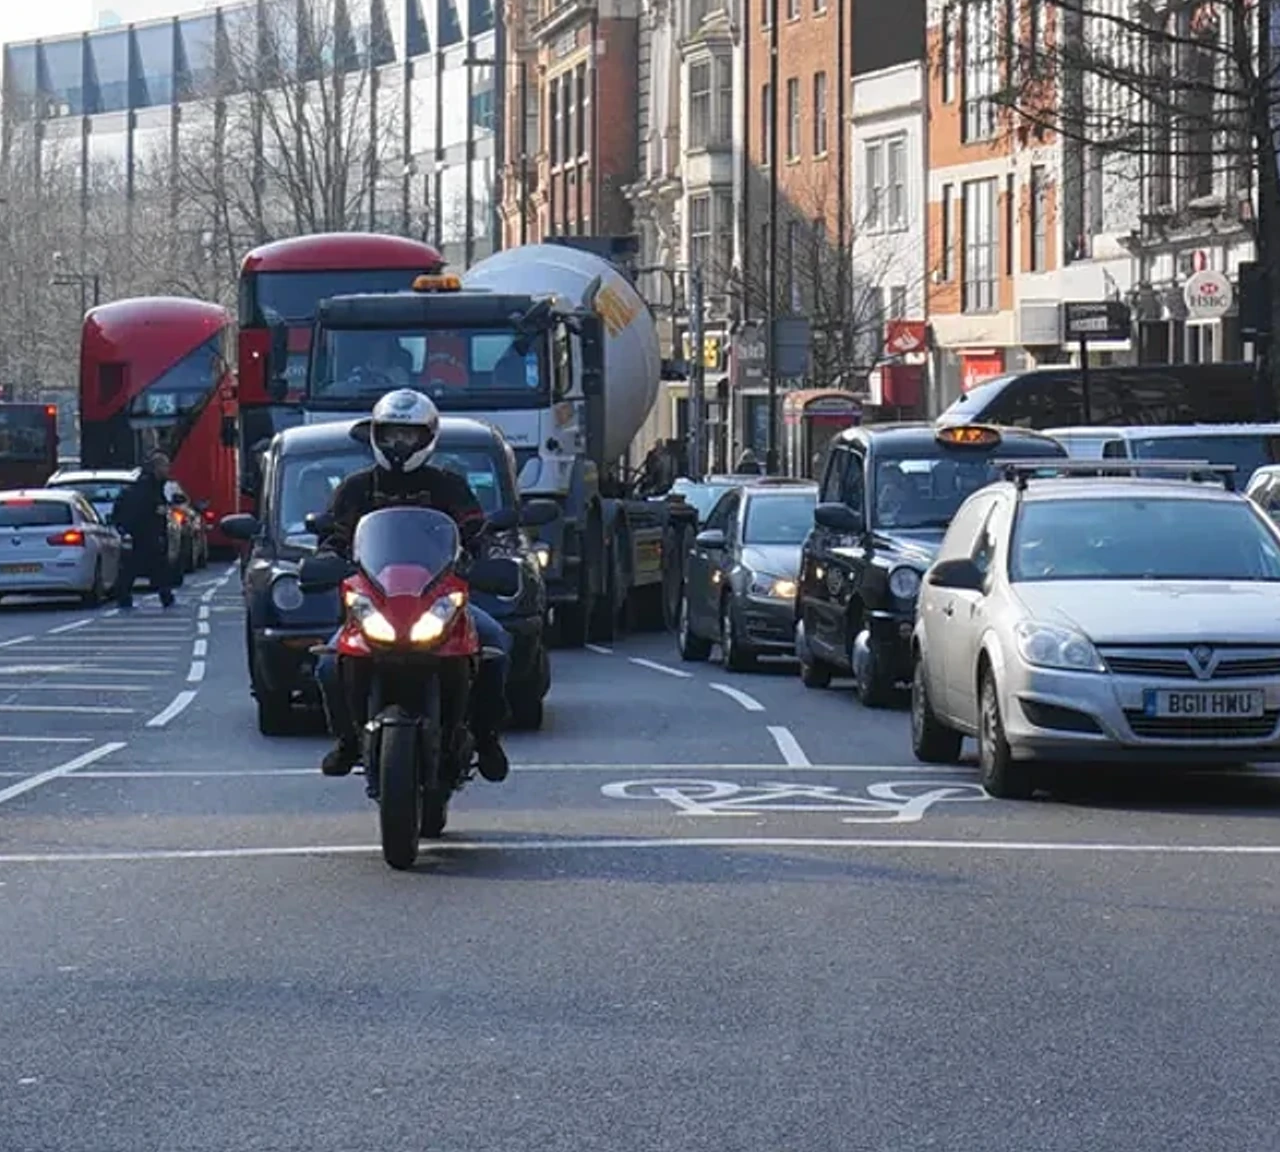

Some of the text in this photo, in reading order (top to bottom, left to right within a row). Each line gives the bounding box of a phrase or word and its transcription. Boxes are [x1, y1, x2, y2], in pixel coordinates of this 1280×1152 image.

[1190, 295, 1227, 308] HSBC
[1169, 693, 1252, 714] BG11 HWU
